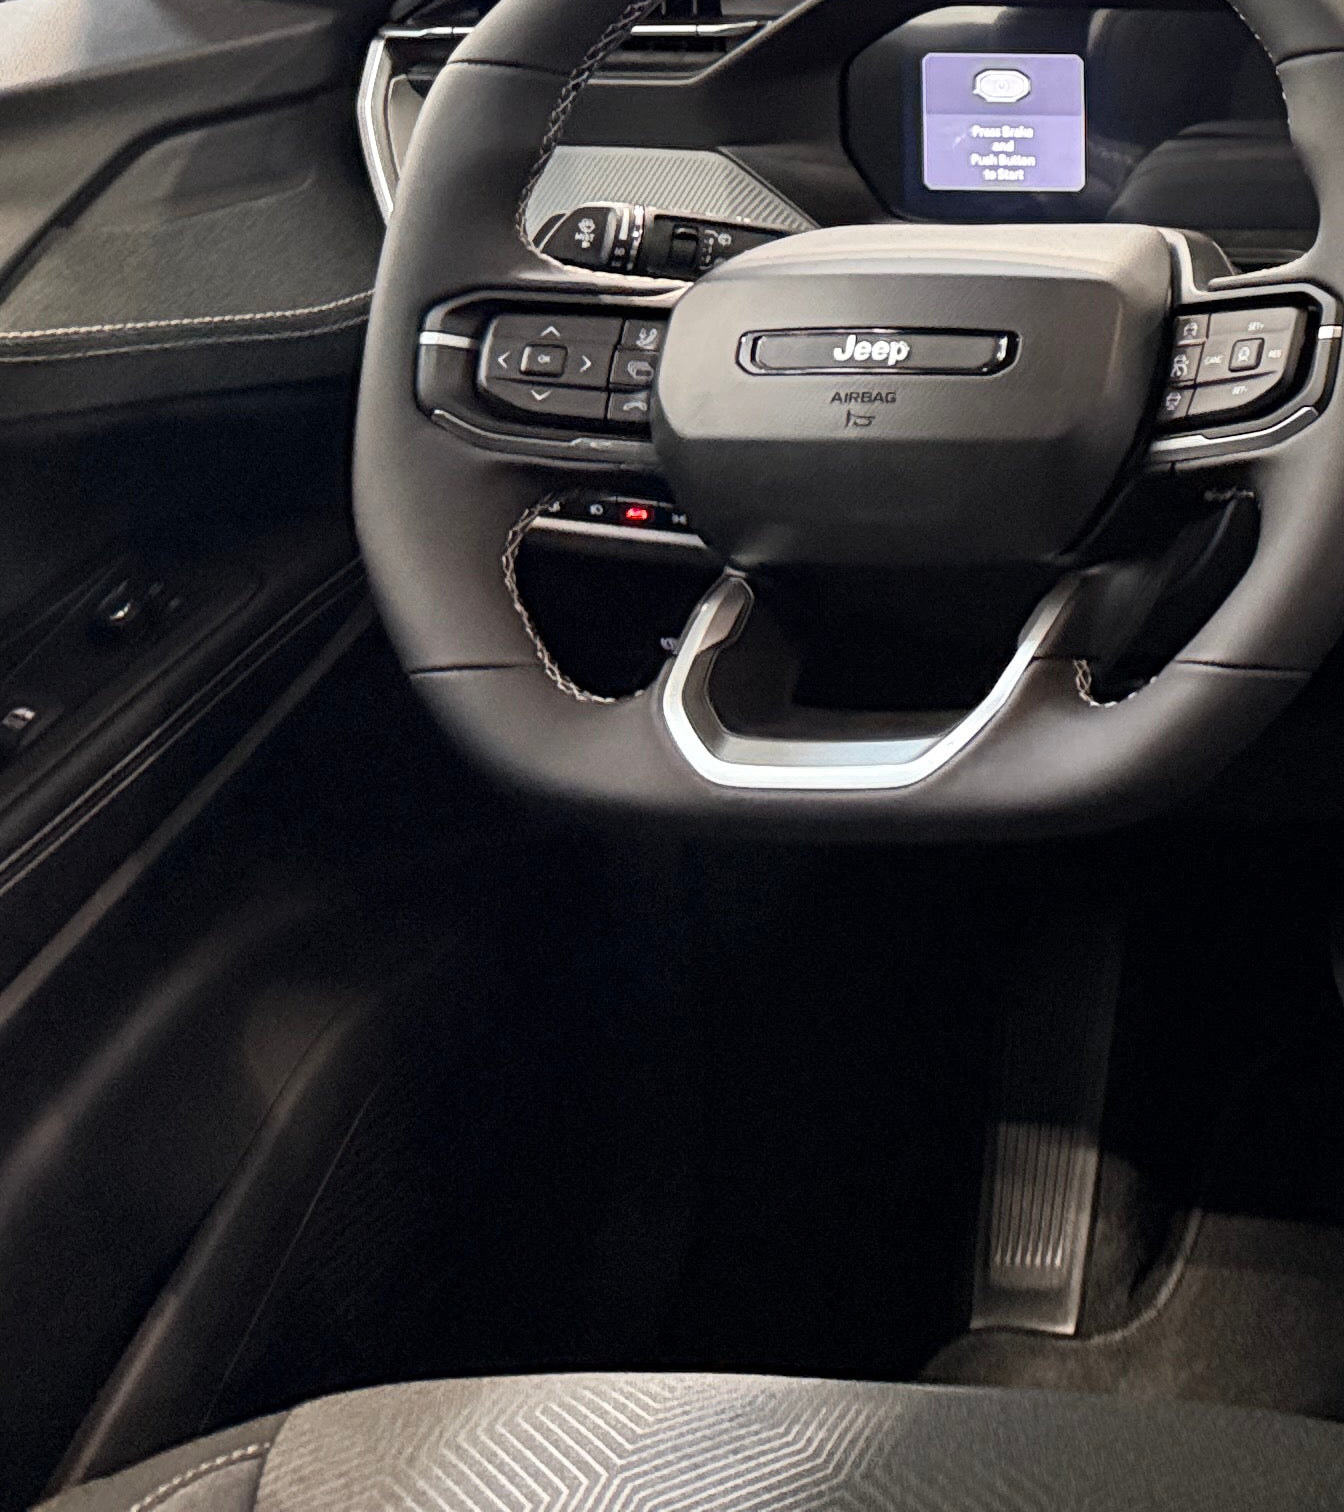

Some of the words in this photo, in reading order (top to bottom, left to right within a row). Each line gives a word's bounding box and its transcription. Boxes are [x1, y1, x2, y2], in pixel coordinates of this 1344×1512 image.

[971, 125, 1001, 138] Press
[1001, 125, 1034, 138] Brake
[991, 140, 1015, 152] and
[970, 153, 998, 166] Push
[998, 153, 1036, 166] Button
[983, 169, 997, 181] to
[997, 168, 1024, 181] Start
[833, 334, 910, 366] Jeep
[830, 391, 897, 404] AIRBAG
